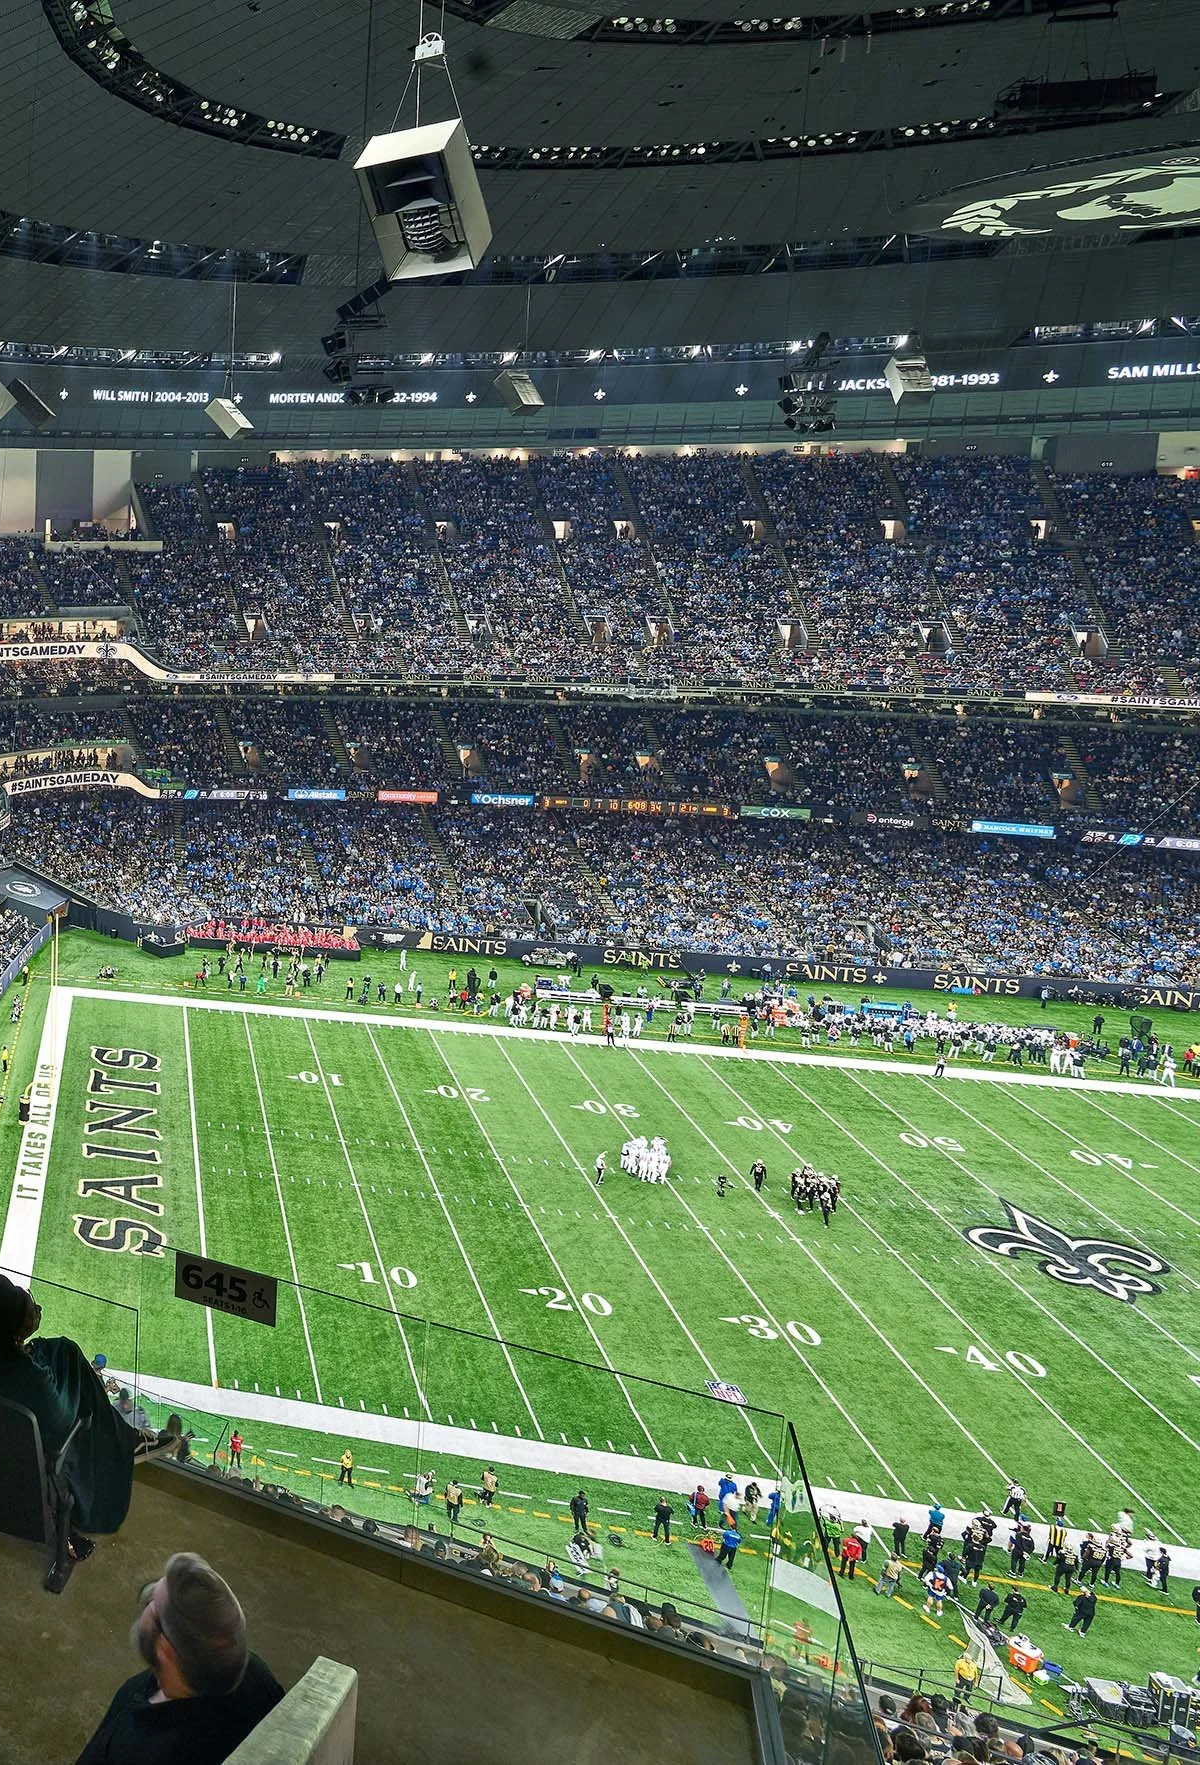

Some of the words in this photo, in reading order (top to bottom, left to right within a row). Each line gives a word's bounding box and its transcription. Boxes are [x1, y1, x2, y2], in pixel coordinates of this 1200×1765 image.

[1108, 365, 1150, 379] SAM
[93, 389, 114, 401] WILL
[115, 390, 148, 402] SMITH
[269, 392, 314, 404] MORTEN
[526, 675, 556, 683] SAINTS
[589, 676, 621, 685] SAINTS
[672, 679, 705, 688] SAINTS
[741, 680, 775, 689] SAINTS
[813, 682, 848, 691] SAINTS
[888, 685, 925, 694] SAINTS
[966, 688, 1004, 698] SAINTS
[11, 773, 119, 792] #SAINTSGAMEDAY
[481, 795, 530, 806] Ochsner
[761, 807, 790, 818] COX
[878, 817, 914, 827] entergy
[932, 819, 968, 828] SAINTS
[433, 935, 507, 955] SAINTS
[934, 974, 1020, 995] SAINTS
[30, 1103, 52, 1127] ALL
[20, 1131, 48, 1176] TAKES
[72, 1046, 167, 1257] SAINTS
[16, 1184, 39, 1200] IT
[354, 1261, 418, 1289] 10
[182, 1264, 248, 1302] 645
[538, 1286, 613, 1316] 20
[737, 1314, 822, 1346] 30
[966, 1345, 1047, 1377] 40
